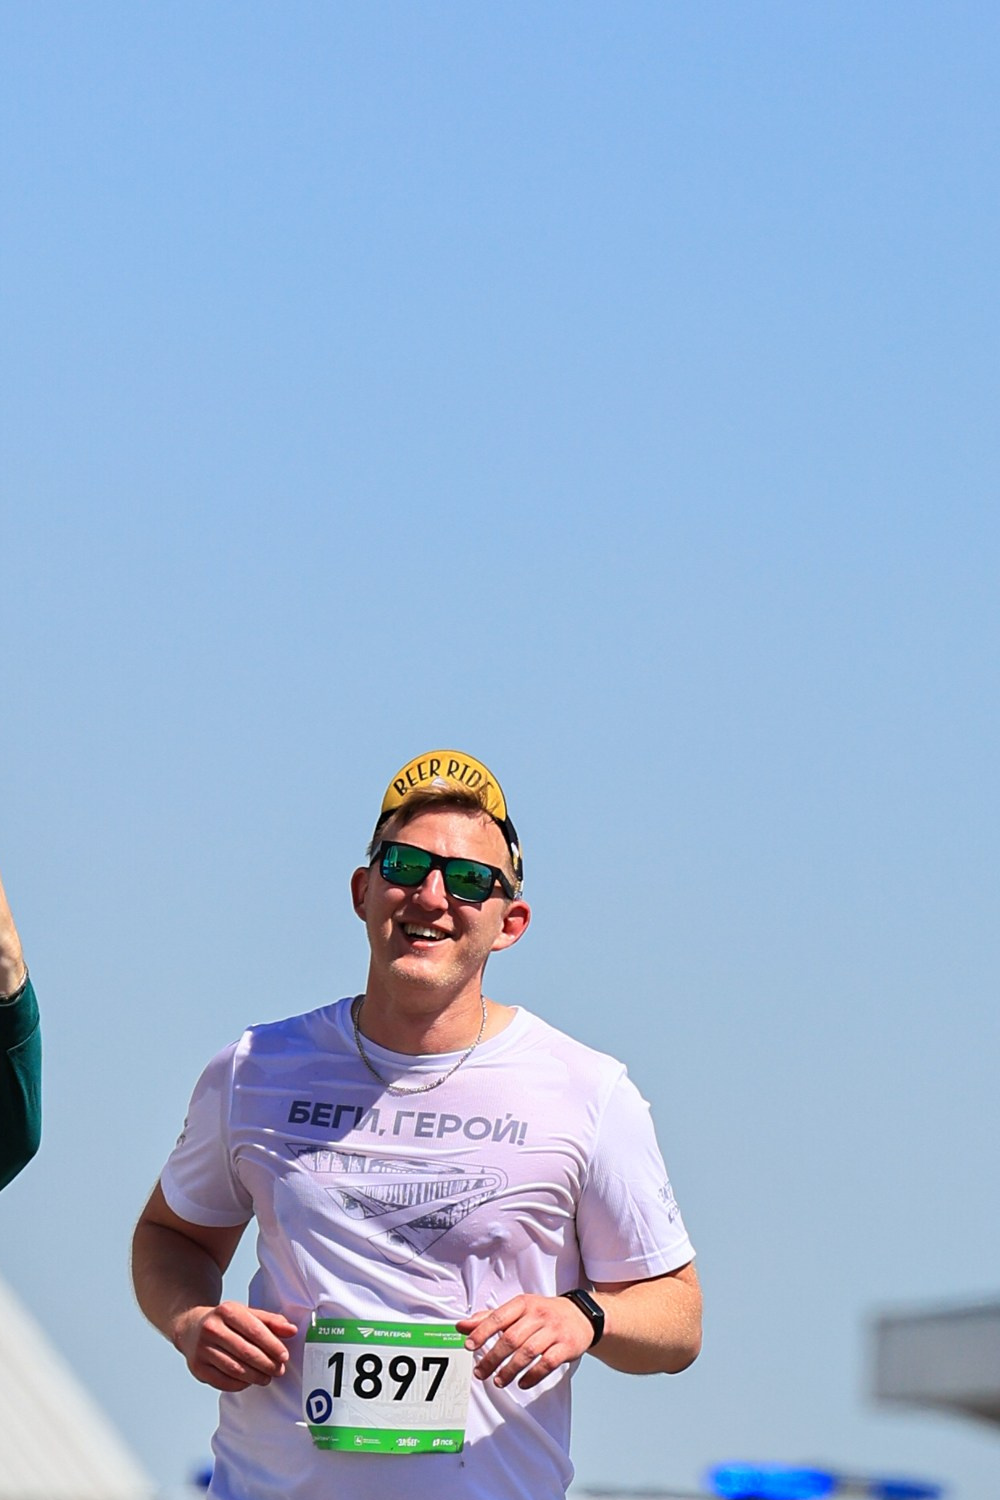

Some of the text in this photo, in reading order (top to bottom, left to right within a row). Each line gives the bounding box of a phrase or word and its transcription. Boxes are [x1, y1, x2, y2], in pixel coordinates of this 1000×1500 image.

[393, 758, 441, 796] BEER
[288, 1100, 528, 1145] БЕГИ, ГЕРОЙ!
[327, 1352, 449, 1401] 1897
[310, 1395, 328, 1419] D
